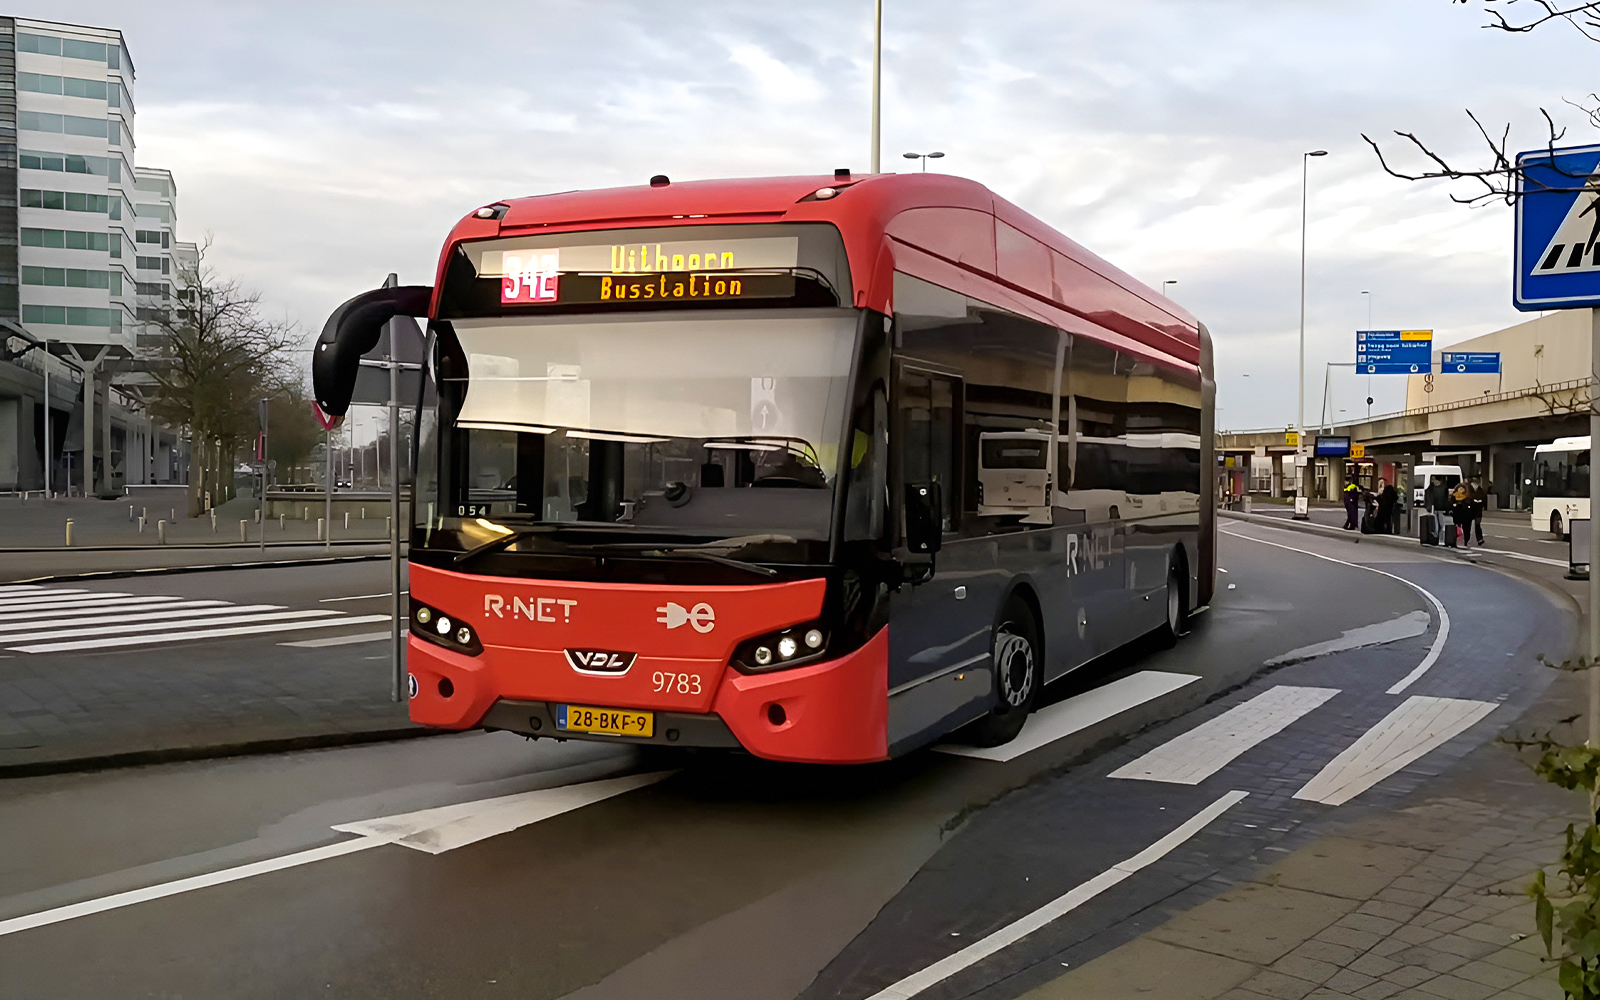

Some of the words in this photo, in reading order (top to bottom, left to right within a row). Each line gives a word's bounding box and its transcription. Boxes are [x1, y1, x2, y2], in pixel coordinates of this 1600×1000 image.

[611, 244, 734, 273] Uithoorn
[600, 274, 742, 300] Busstation
[575, 651, 624, 668] VDL
[652, 671, 702, 695] 9783
[573, 710, 647, 732] 28-BKF-9
